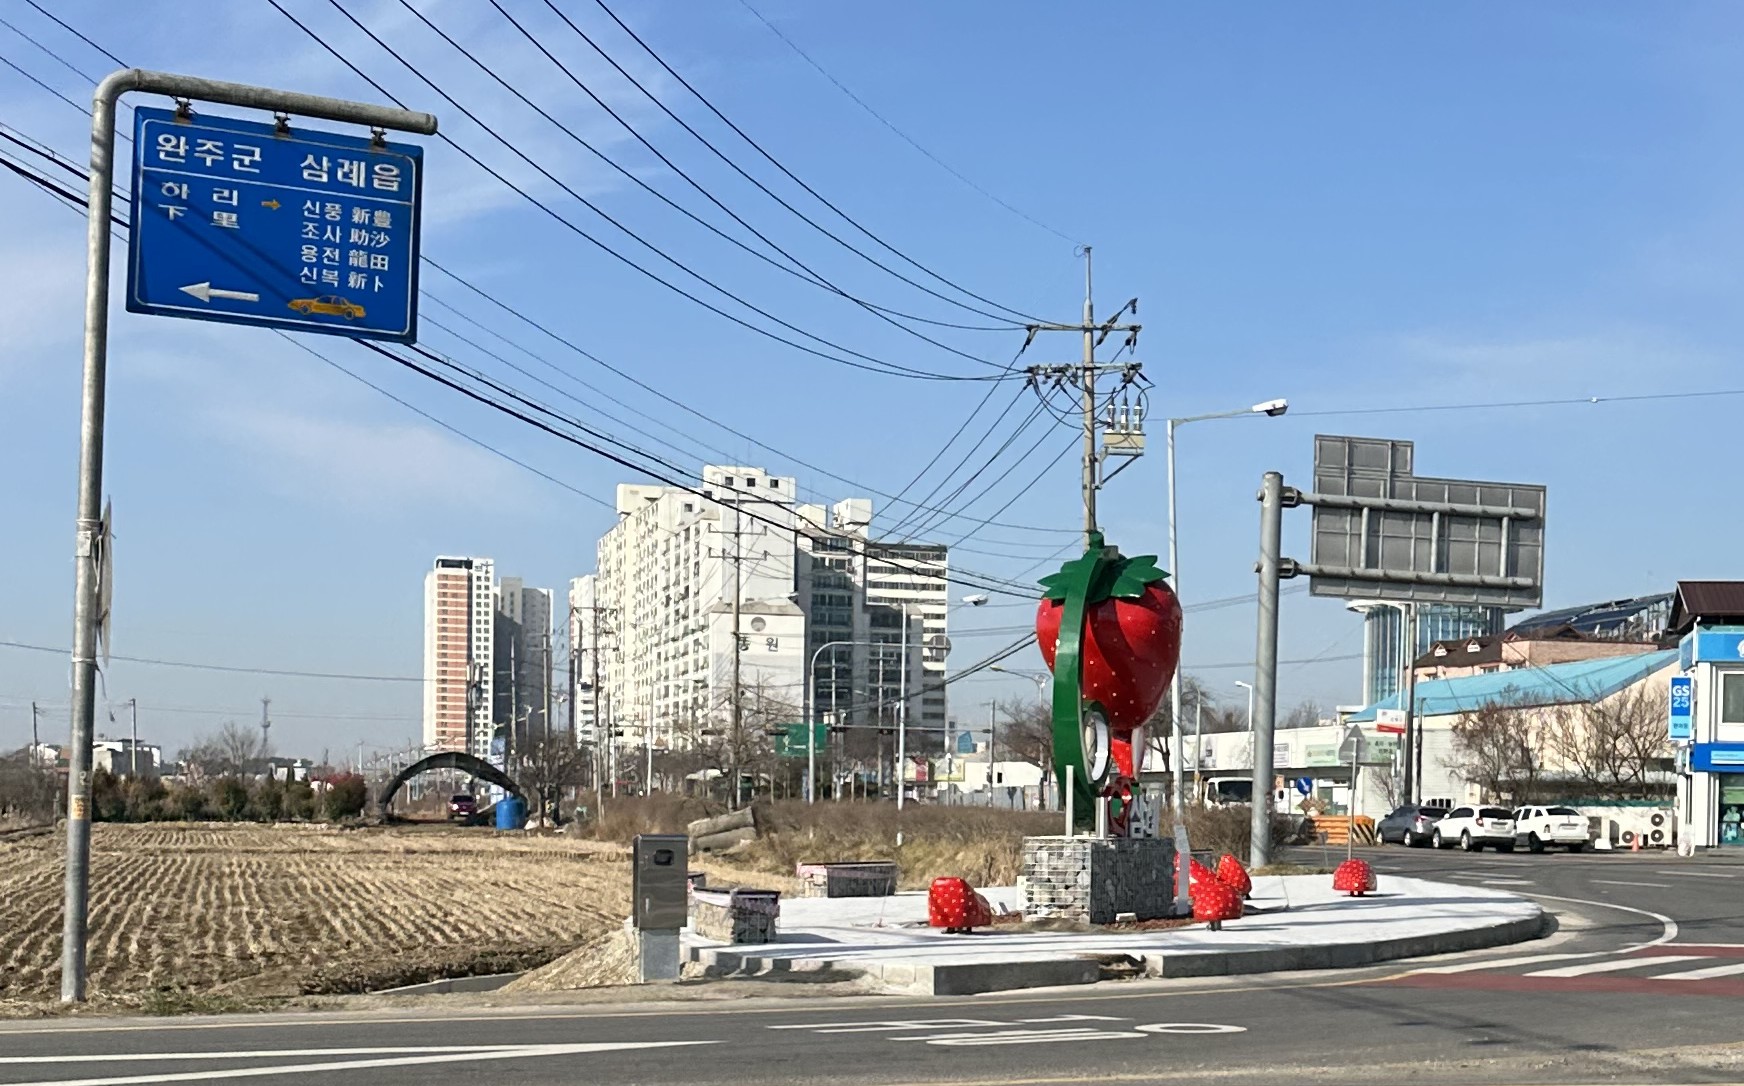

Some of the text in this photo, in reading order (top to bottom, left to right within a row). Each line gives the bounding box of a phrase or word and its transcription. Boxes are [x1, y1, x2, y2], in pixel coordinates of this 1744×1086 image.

[156, 133, 402, 192] 완주군 삼례읍
[302, 199, 342, 221] 신풍
[301, 221, 391, 248] 조사 助沙
[300, 244, 389, 271] 용전 龍田
[299, 266, 340, 288] 신복
[1672, 685, 1690, 697] GS
[1672, 696, 1690, 708] 25
